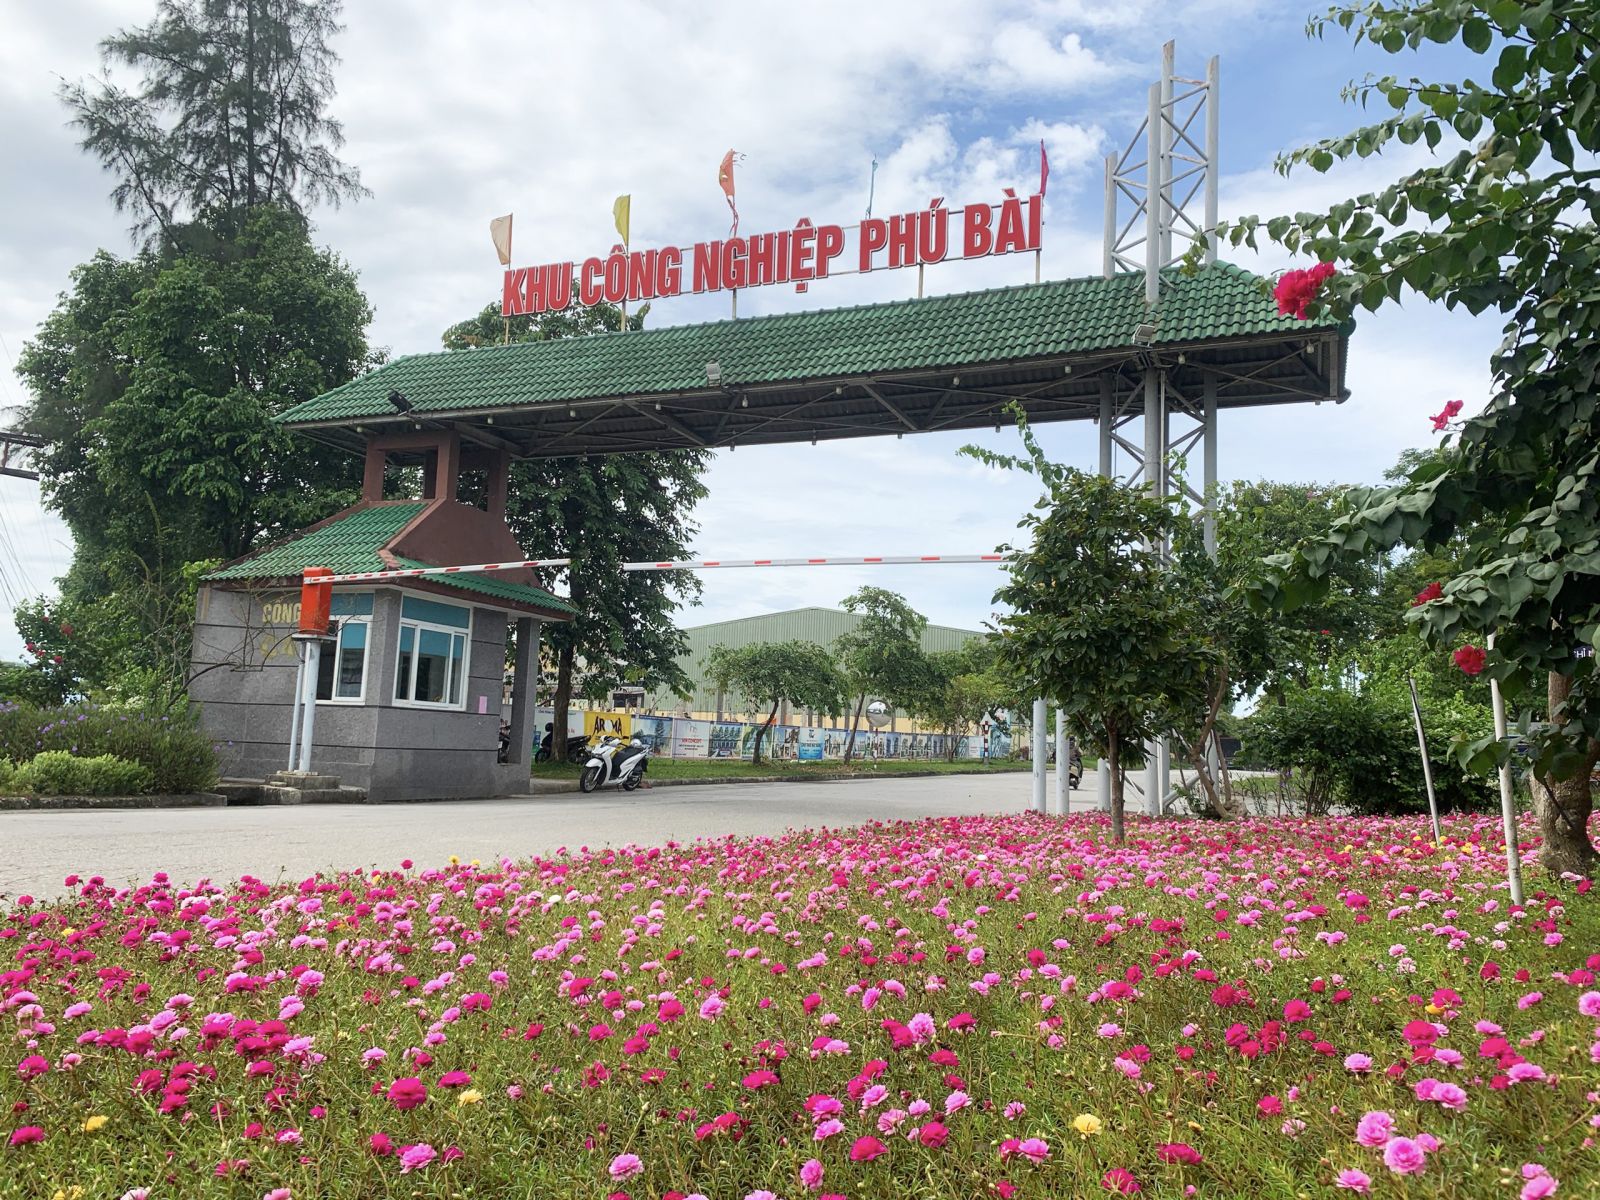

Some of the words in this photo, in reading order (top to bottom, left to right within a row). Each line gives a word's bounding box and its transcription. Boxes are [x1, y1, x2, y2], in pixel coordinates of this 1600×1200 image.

[502, 261, 574, 317] KHU
[579, 243, 683, 307] CÔNG
[692, 217, 845, 293] NGHIỆP
[859, 196, 949, 273] PHÚ
[963, 187, 1043, 260] BÀI
